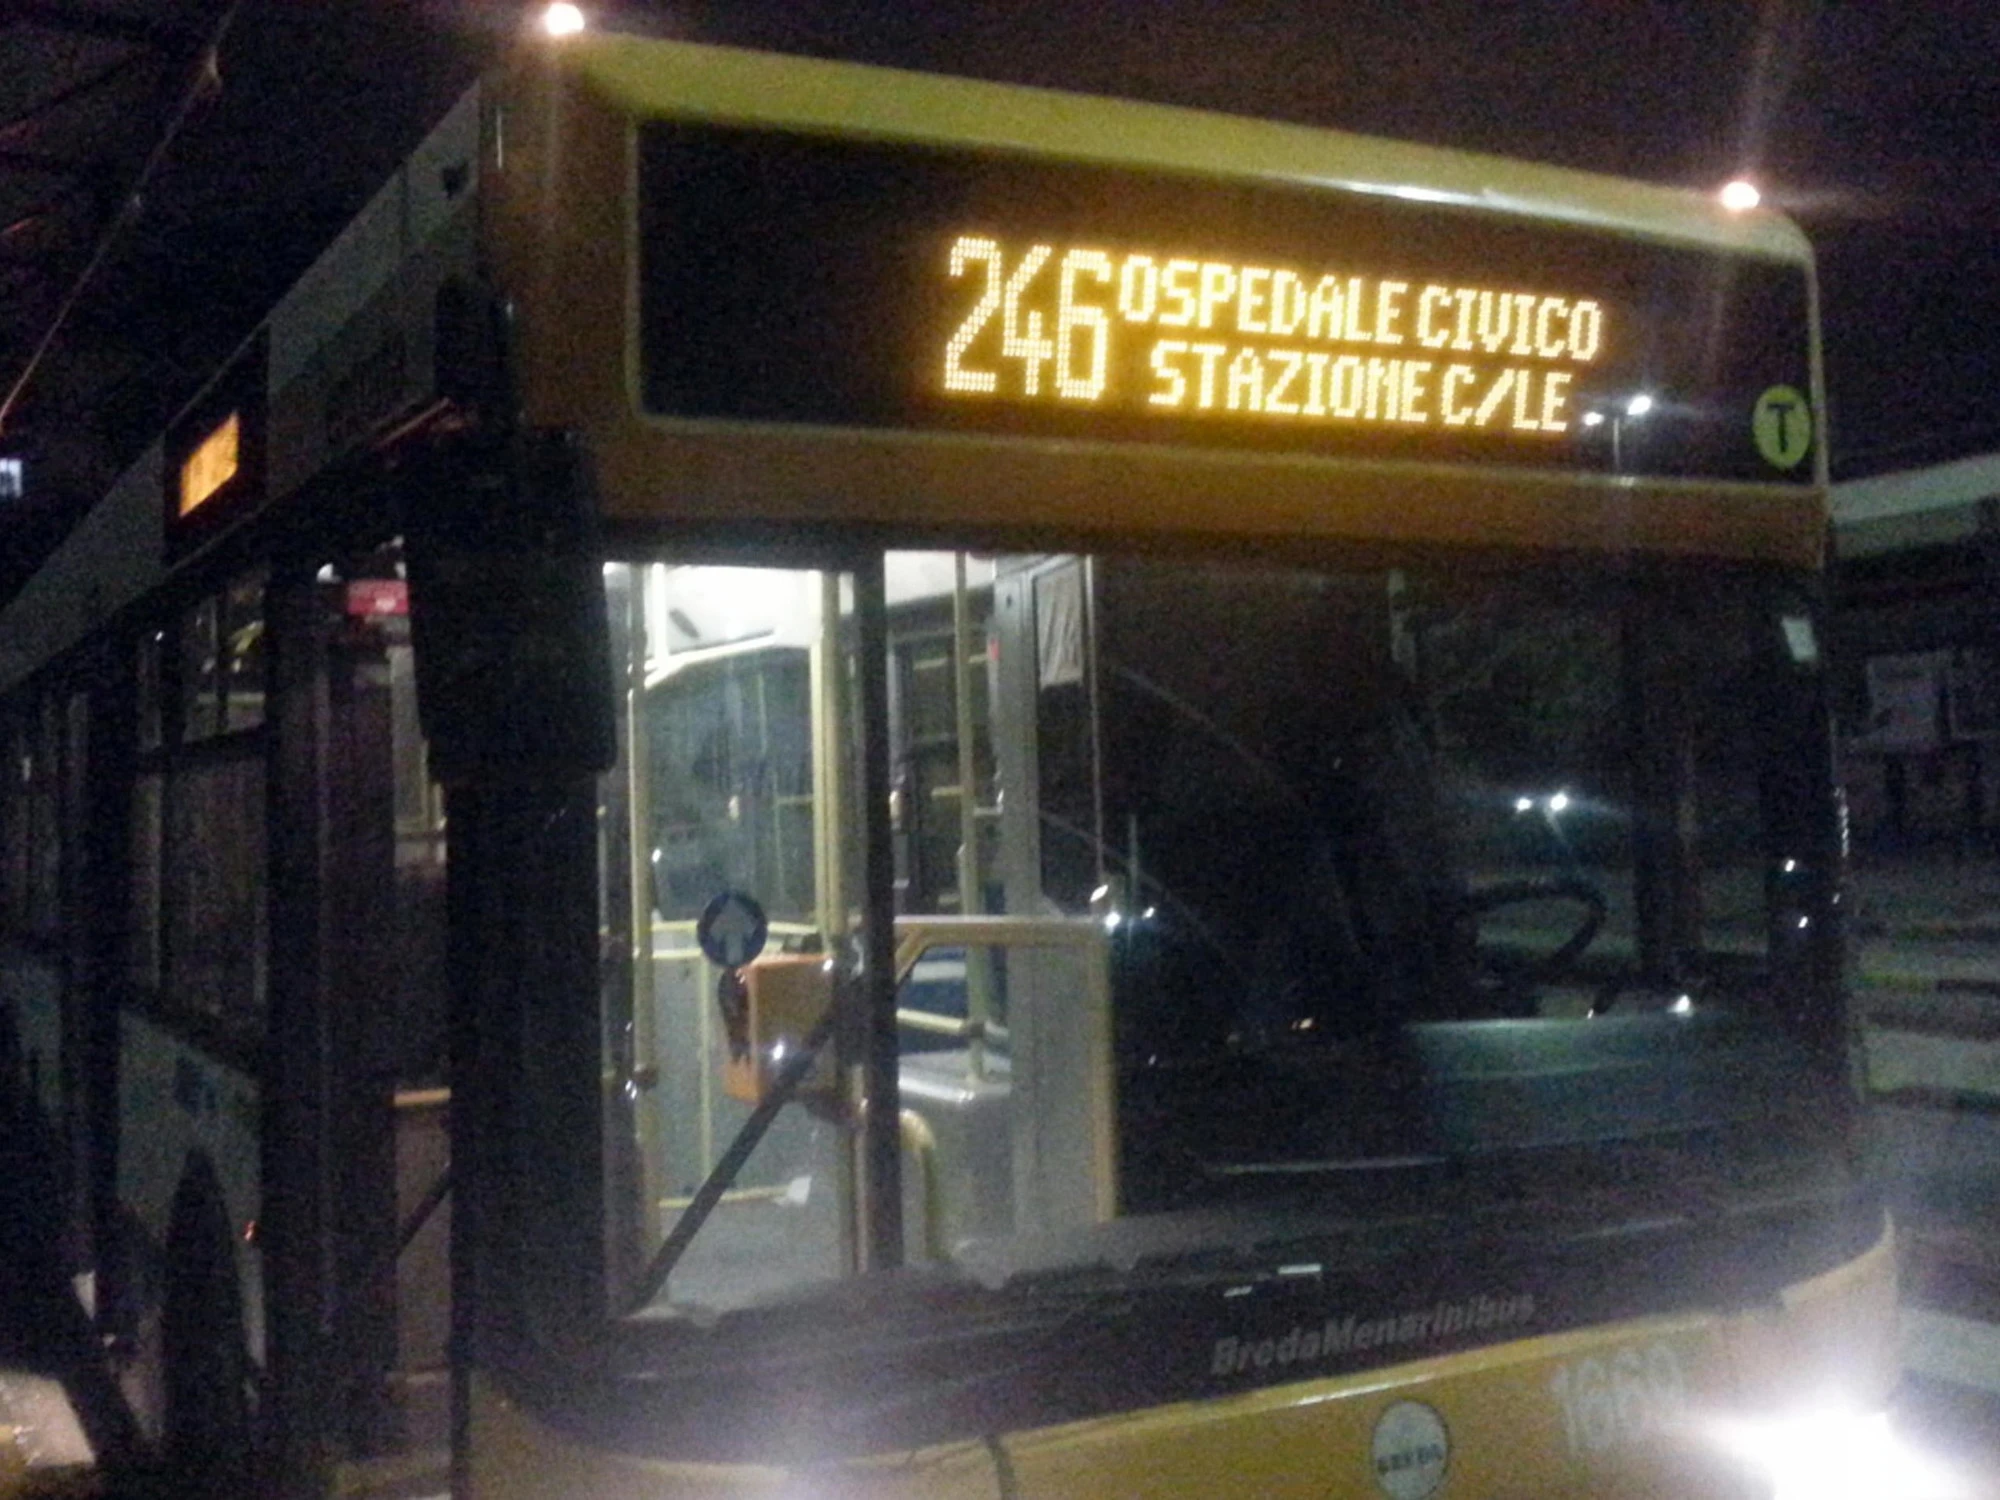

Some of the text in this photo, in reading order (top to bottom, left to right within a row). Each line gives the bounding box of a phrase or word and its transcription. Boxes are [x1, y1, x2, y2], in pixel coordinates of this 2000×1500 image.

[944, 236, 1111, 401] 246
[1117, 254, 1602, 361] OSPEDALE CIVICO
[1148, 340, 1572, 432] STAZIONE C/LE
[1765, 402, 1795, 454] T
